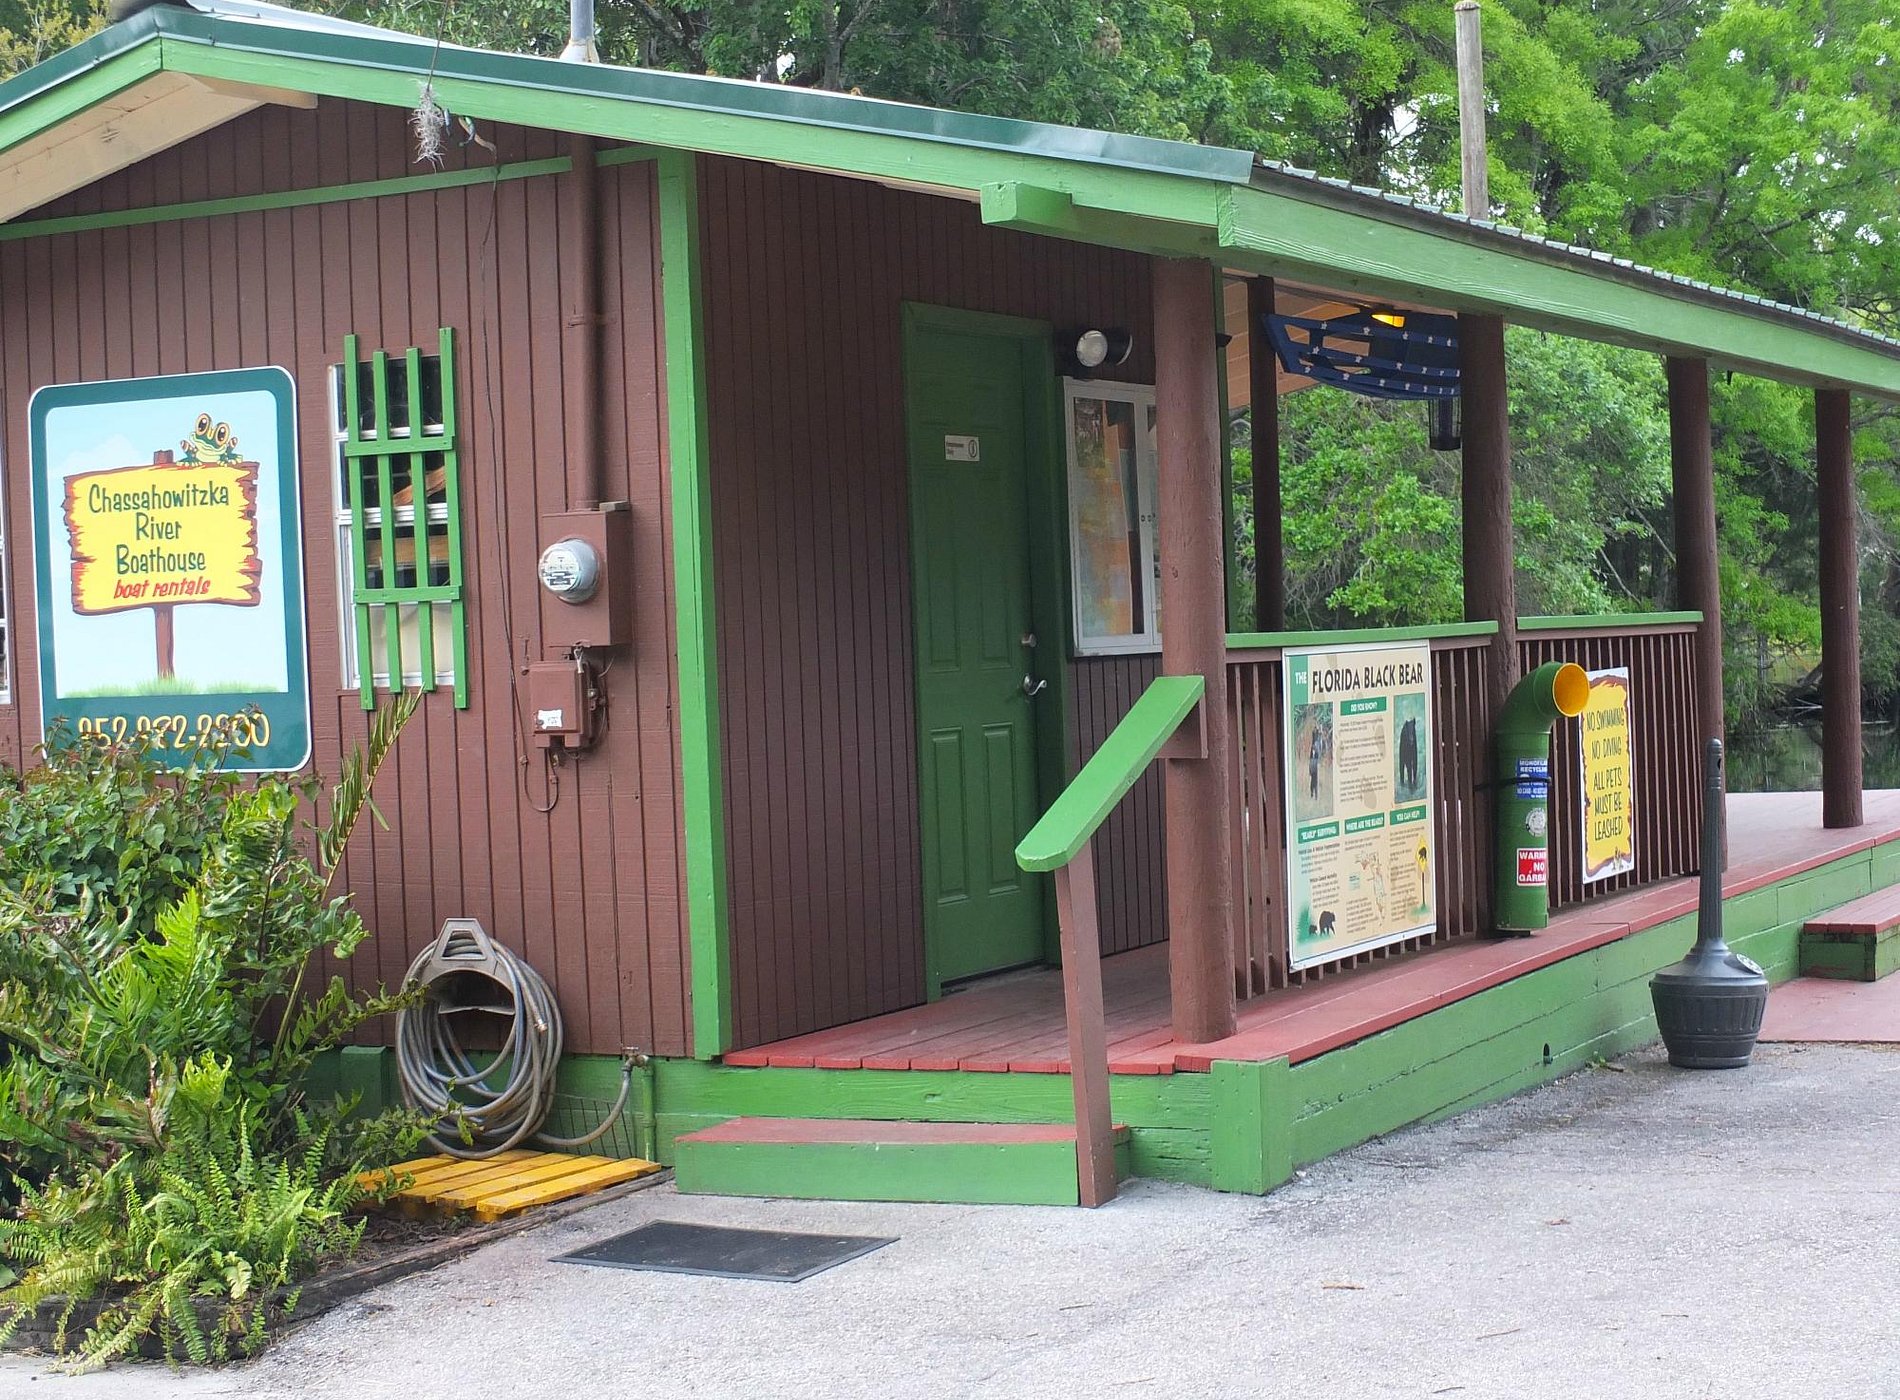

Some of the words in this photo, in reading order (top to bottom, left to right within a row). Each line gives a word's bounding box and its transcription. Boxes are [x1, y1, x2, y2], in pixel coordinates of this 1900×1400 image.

[88, 480, 229, 513] Chassahowitzka
[135, 511, 182, 541] River
[116, 543, 206, 575] Boathouse
[113, 579, 149, 599] boat
[152, 575, 211, 597] rentals
[1295, 671, 1307, 685] THE
[1312, 668, 1361, 694] FLORIDA
[1364, 664, 1396, 689] BLACK
[1399, 662, 1423, 686] BEAR
[1586, 711, 1596, 732] NO
[1597, 707, 1624, 731] SWIMMING
[1591, 740, 1600, 760] NO
[1603, 736, 1621, 758] DIVING
[1593, 771, 1605, 791] ALL
[1606, 767, 1622, 788] PETS
[1594, 793, 1612, 816] MUST
[1613, 791, 1622, 812] BE
[1594, 816, 1623, 841] LEASHED
[1533, 861, 1545, 872] NO
